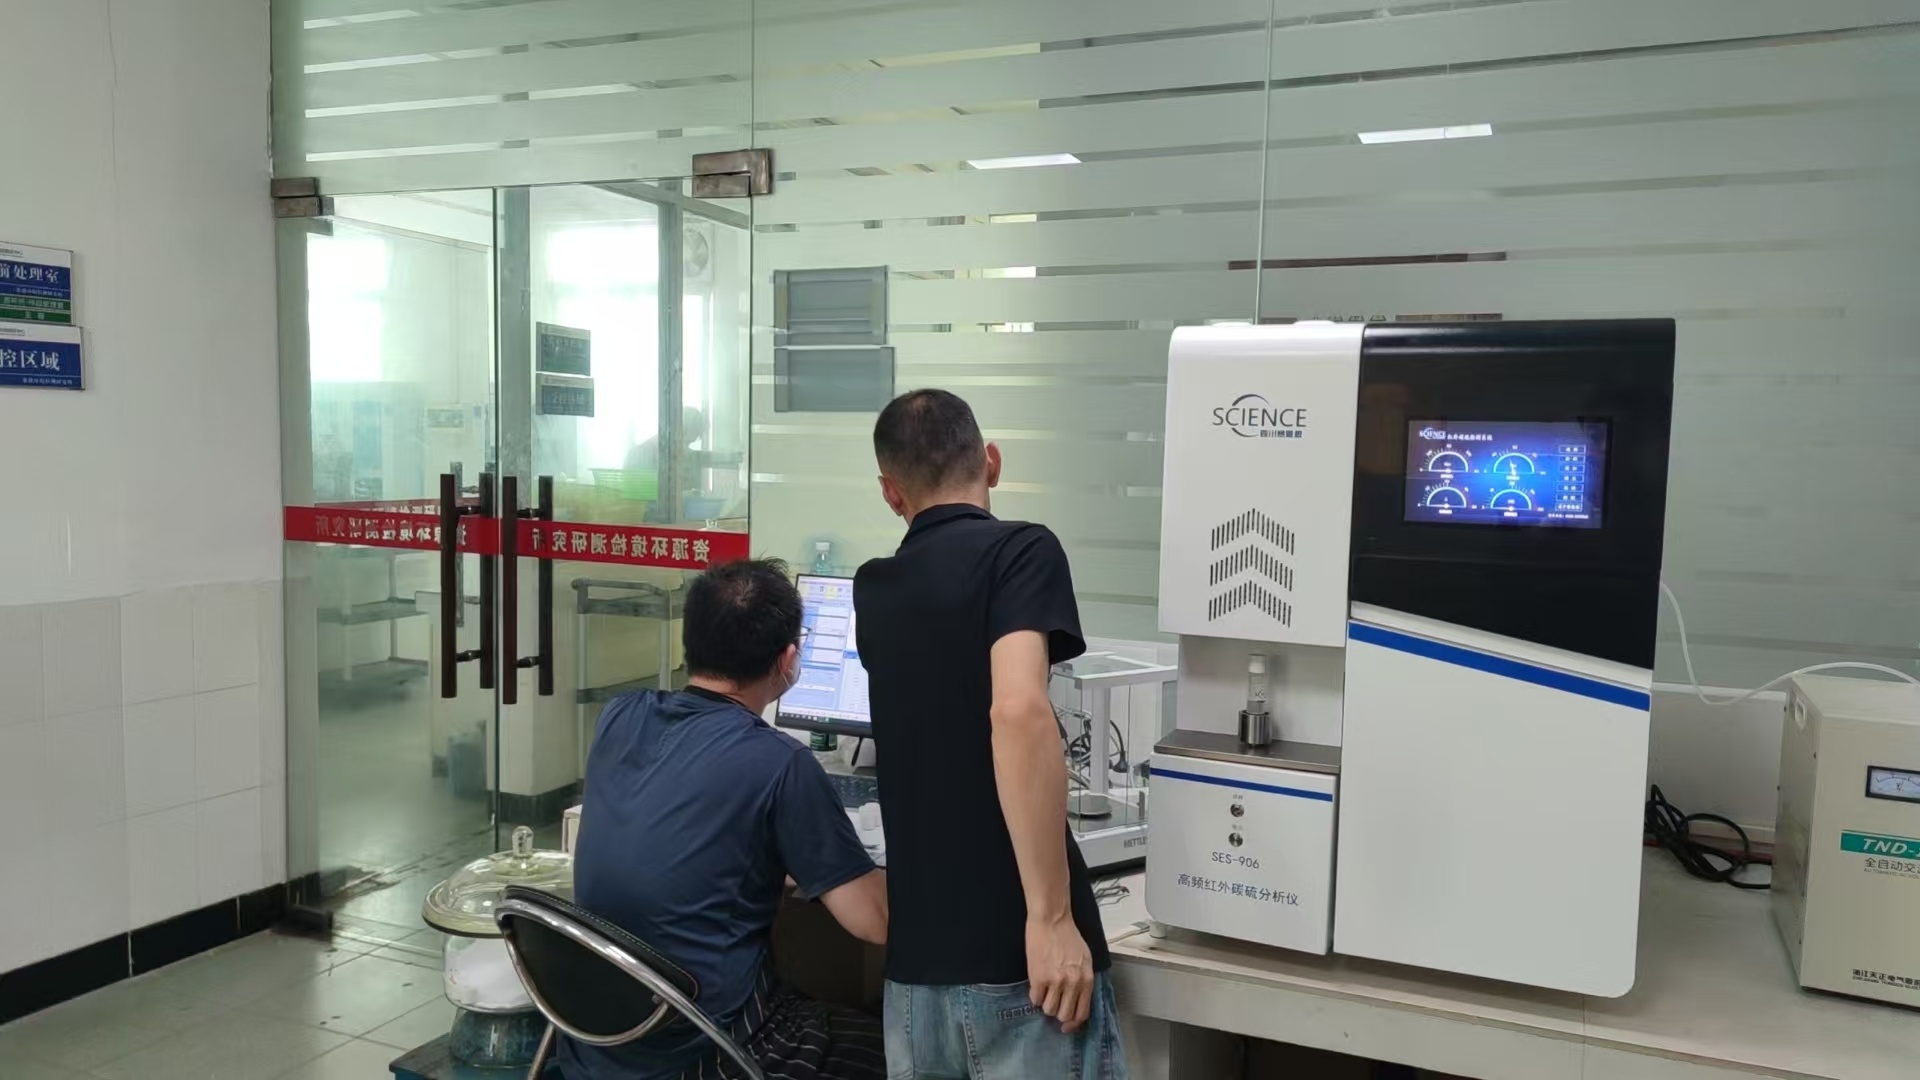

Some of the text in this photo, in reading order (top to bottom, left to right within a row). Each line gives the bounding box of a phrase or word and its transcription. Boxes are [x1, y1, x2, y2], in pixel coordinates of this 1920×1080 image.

[0, 349, 60, 371] 控区域
[1212, 406, 1307, 427] SCIENCE
[1211, 851, 1260, 870] SES-906
[1177, 873, 1299, 906] 高频红外碳硫分析仪
